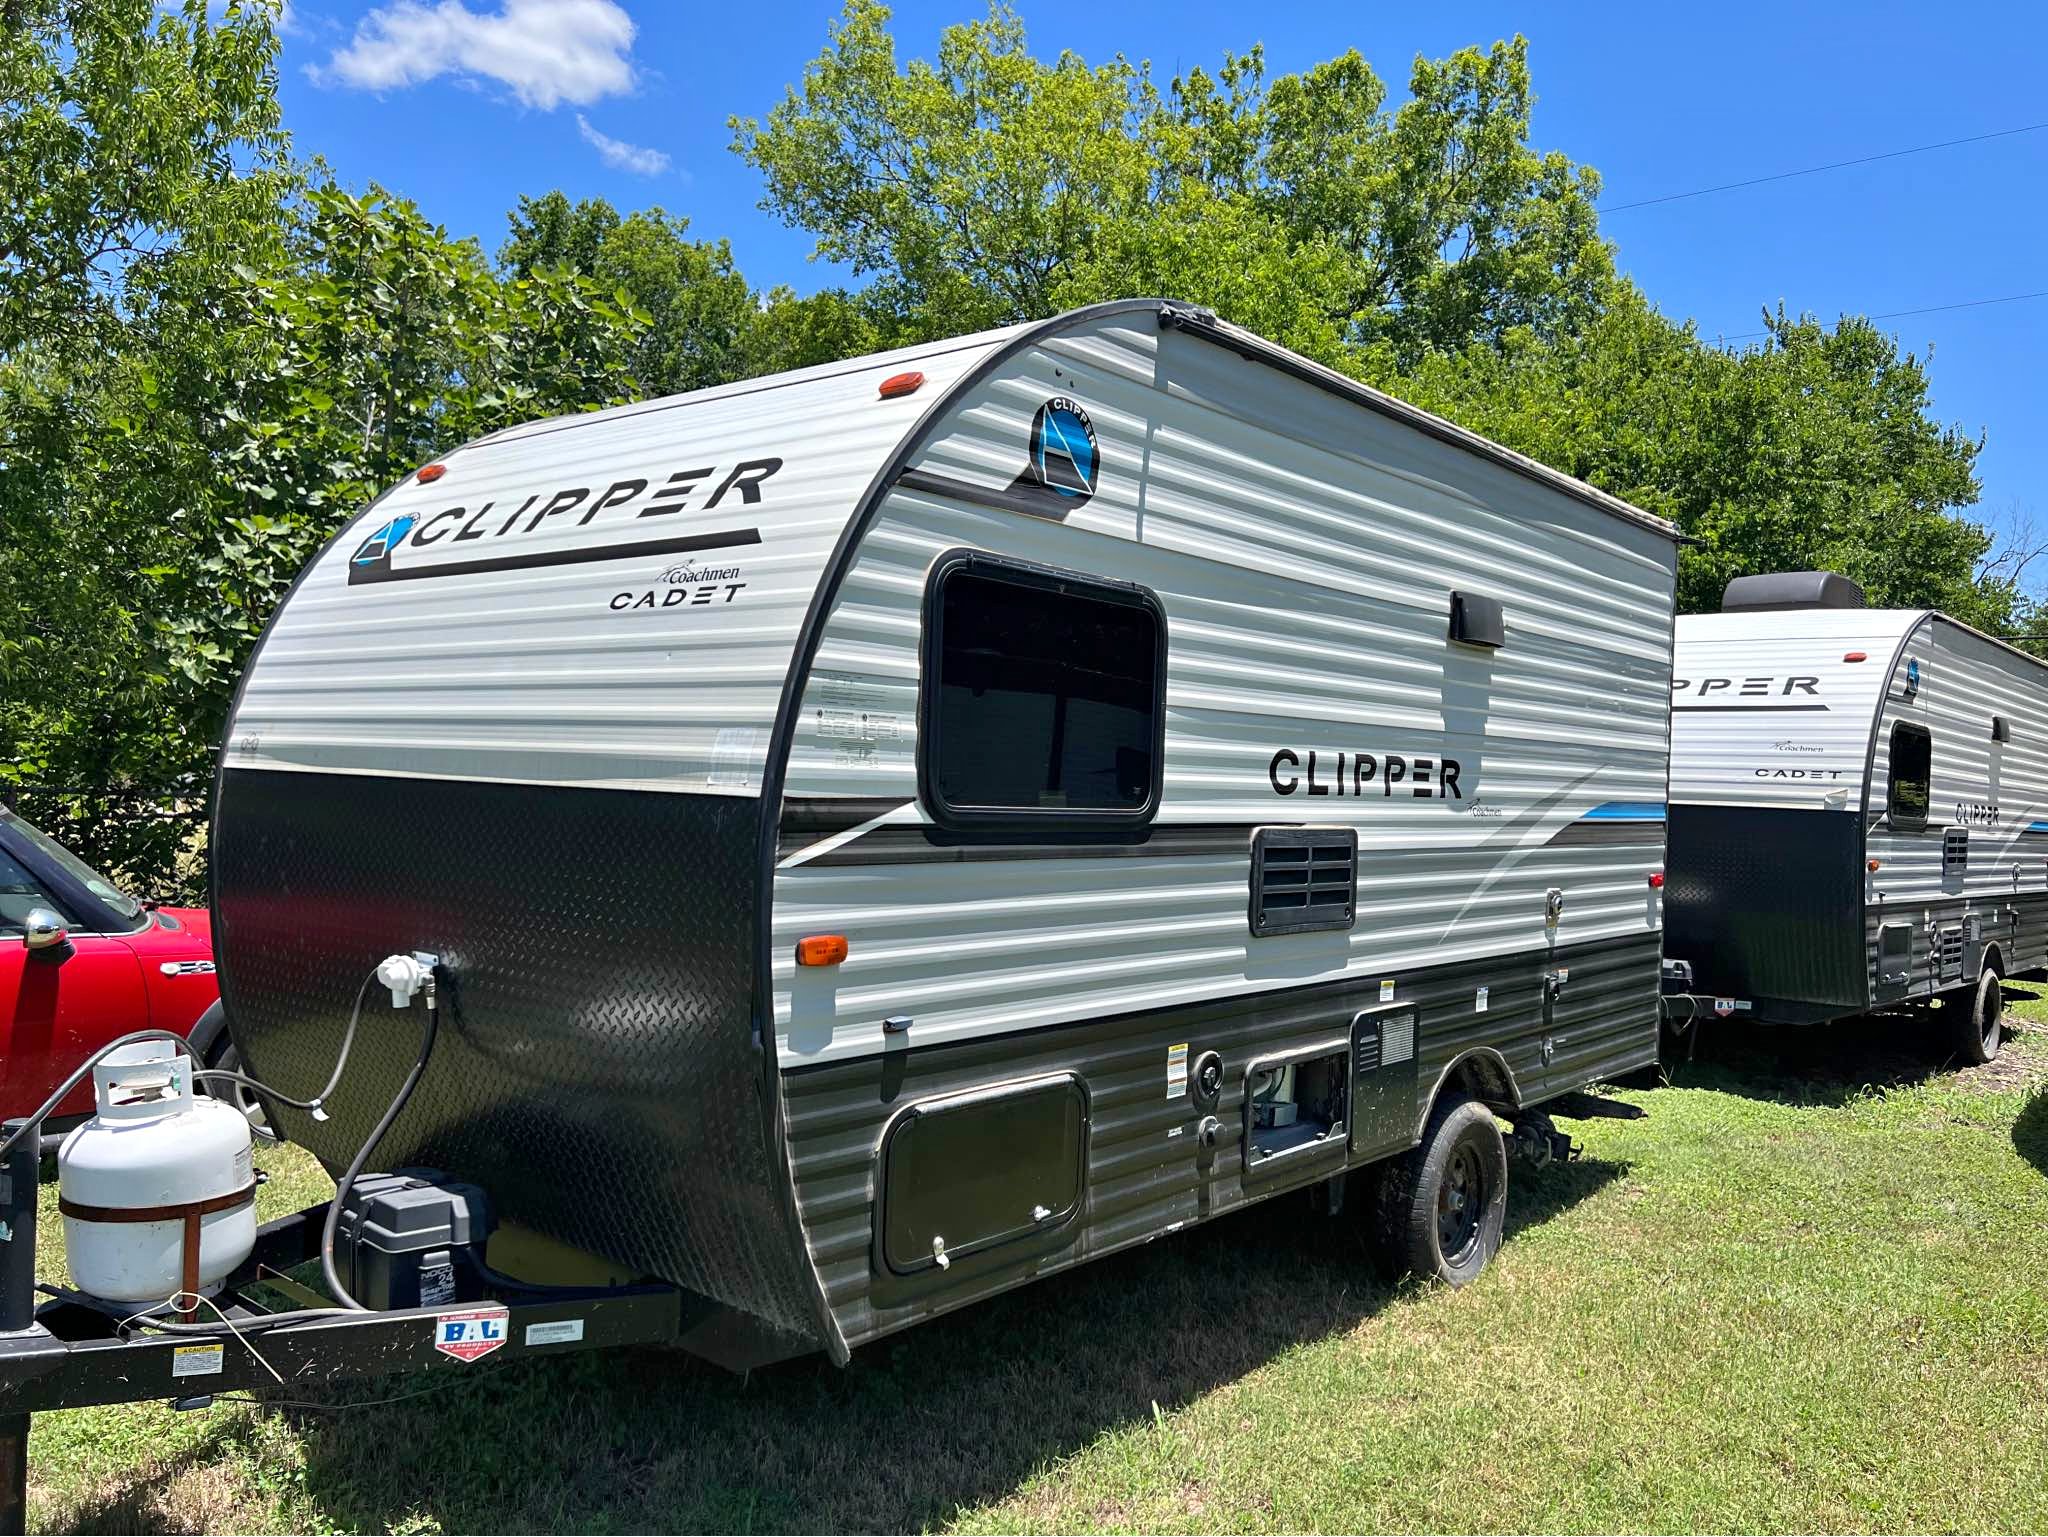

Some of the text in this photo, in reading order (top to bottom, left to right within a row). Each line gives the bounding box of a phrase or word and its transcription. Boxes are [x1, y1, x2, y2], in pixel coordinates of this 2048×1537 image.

[1053, 398, 1096, 449] CLIPPER
[410, 457, 784, 547] CLIPPER
[669, 567, 740, 584] Coachmen
[609, 583, 747, 610] CADET
[1269, 748, 1462, 799] CLIPPER
[1755, 768, 1842, 780] CADET
[1955, 802, 2000, 826] CLIPPER
[420, 1265, 454, 1280] NOCO
[438, 1271, 454, 1286] 24
[188, 1346, 216, 1354] CAUTION
